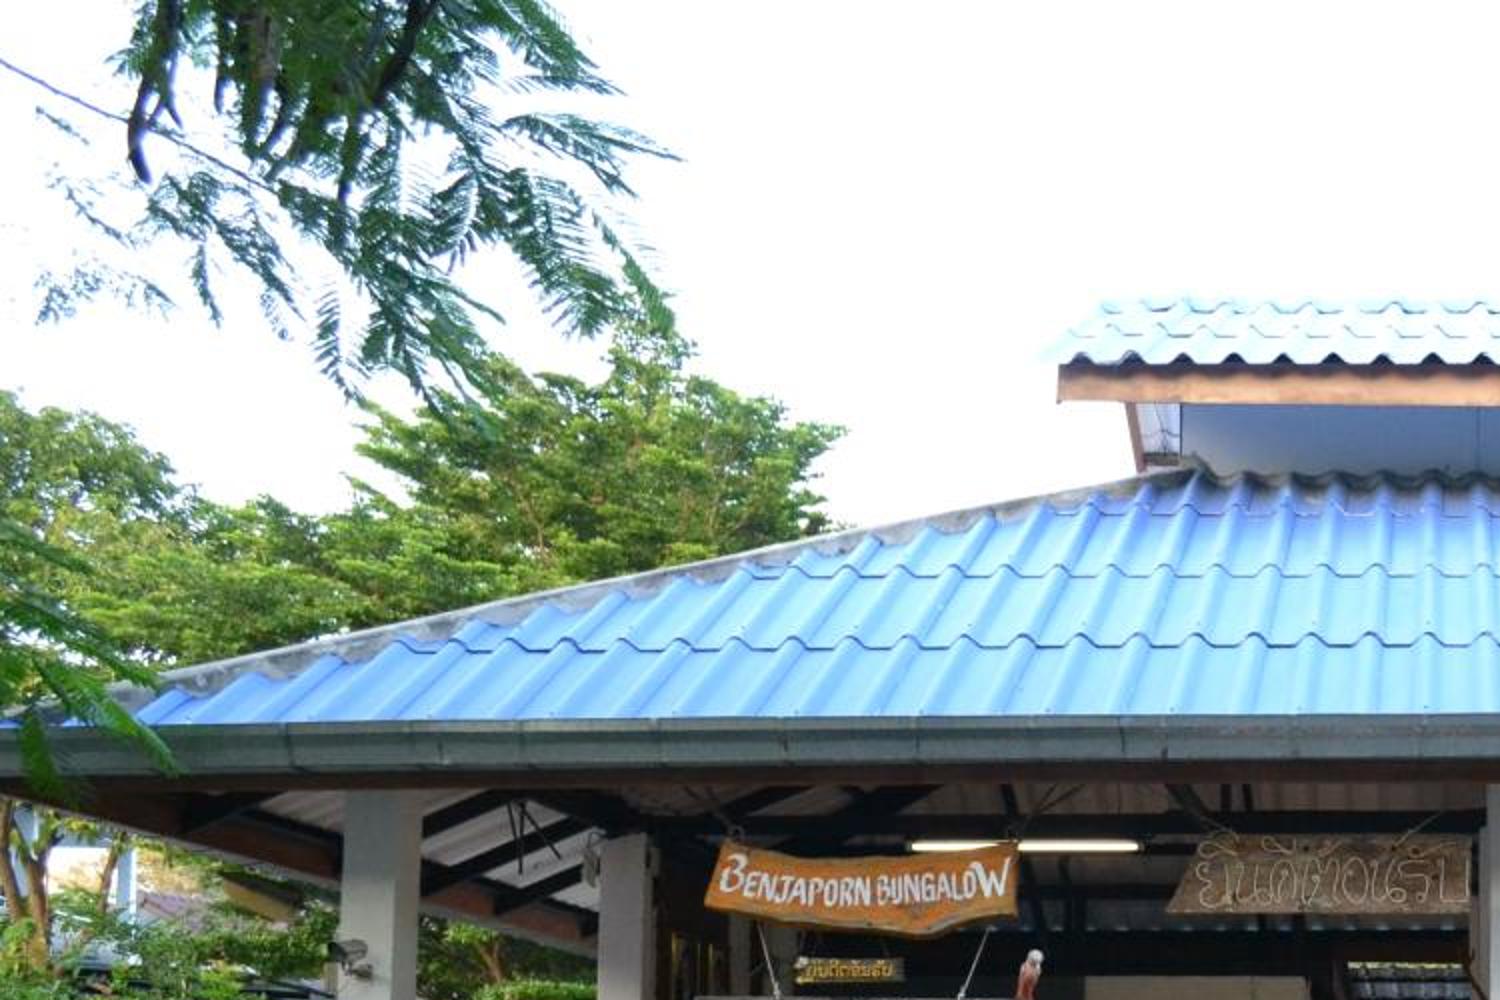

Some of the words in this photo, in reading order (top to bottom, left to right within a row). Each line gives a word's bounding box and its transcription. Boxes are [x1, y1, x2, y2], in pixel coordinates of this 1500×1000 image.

[718, 852, 872, 908] BENJAPORN
[876, 855, 1012, 905] BUNGALOW
[1194, 832, 1472, 910] ยินดีต้อนรับ
